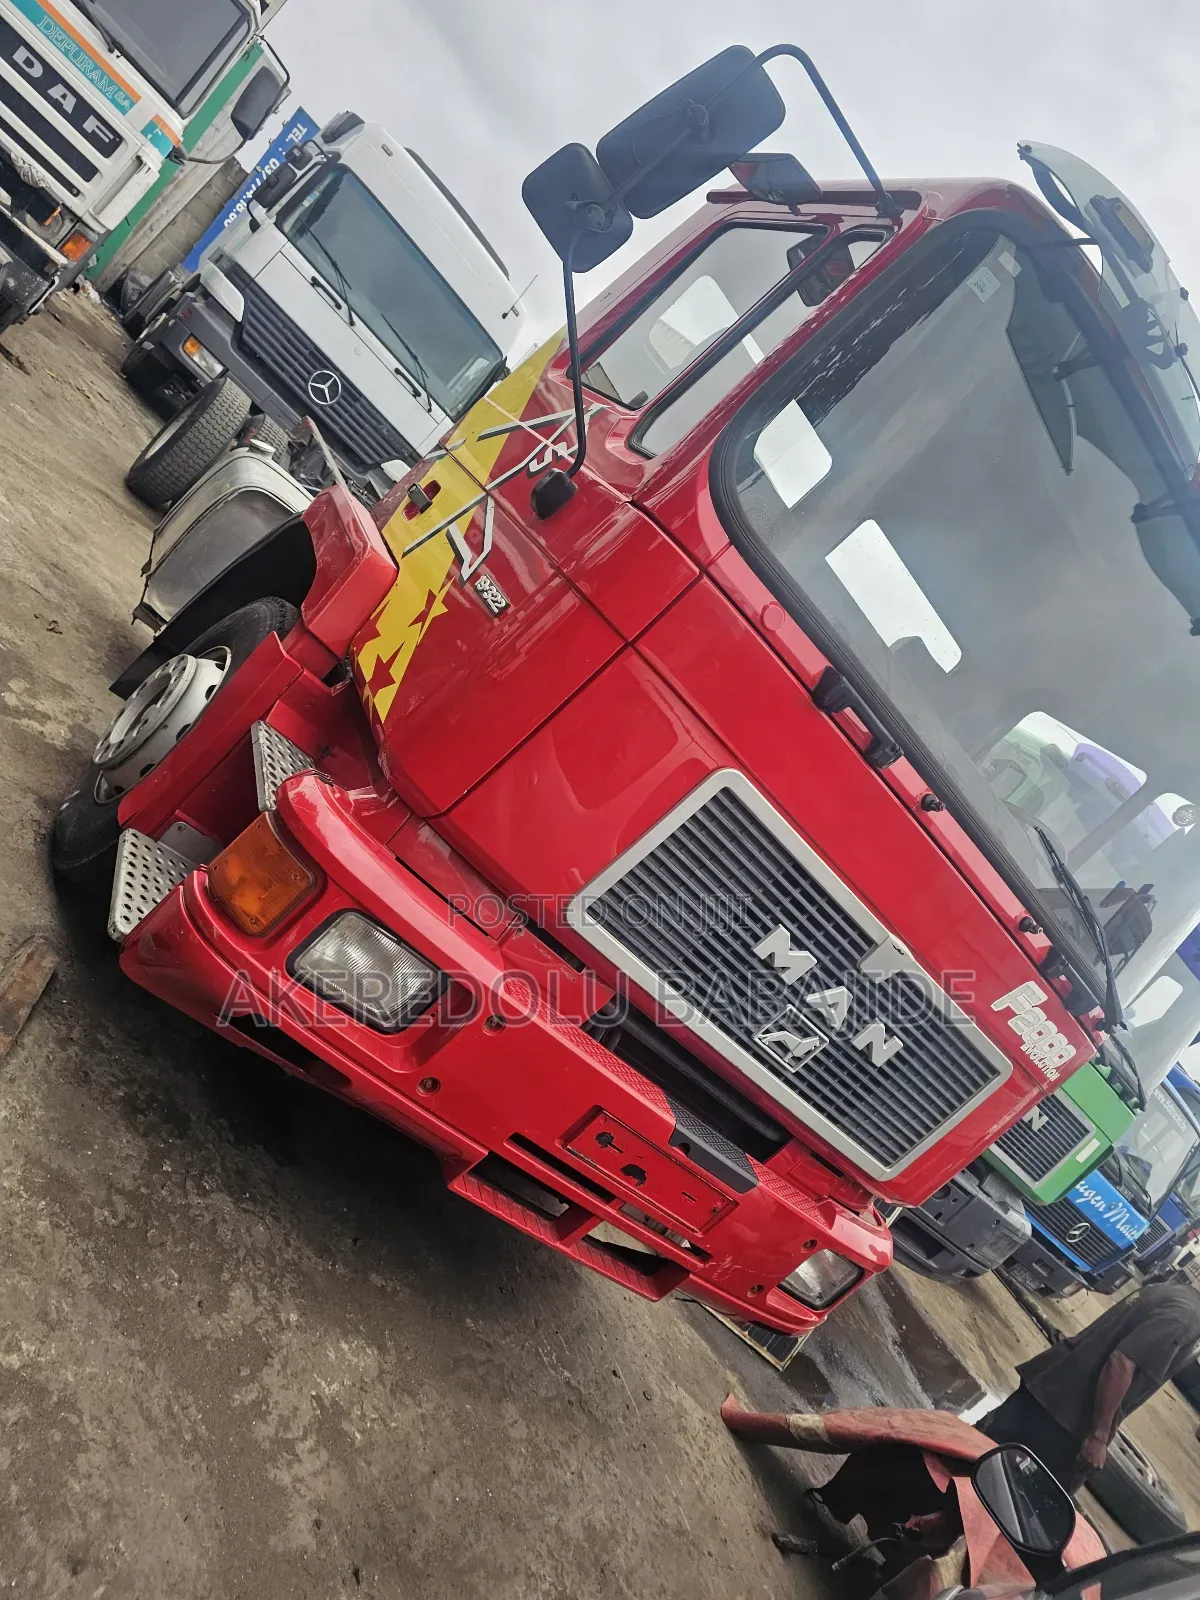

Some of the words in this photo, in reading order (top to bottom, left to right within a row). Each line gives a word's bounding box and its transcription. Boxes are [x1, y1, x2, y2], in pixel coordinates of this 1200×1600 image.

[12, 45, 115, 144] DAF
[37, 14, 117, 99] DEPURAM
[285, 122, 308, 143] TEL.
[752, 923, 904, 1068] MAN
[990, 980, 1077, 1069] F2000
[1020, 1043, 1061, 1082] EVOLUTION
